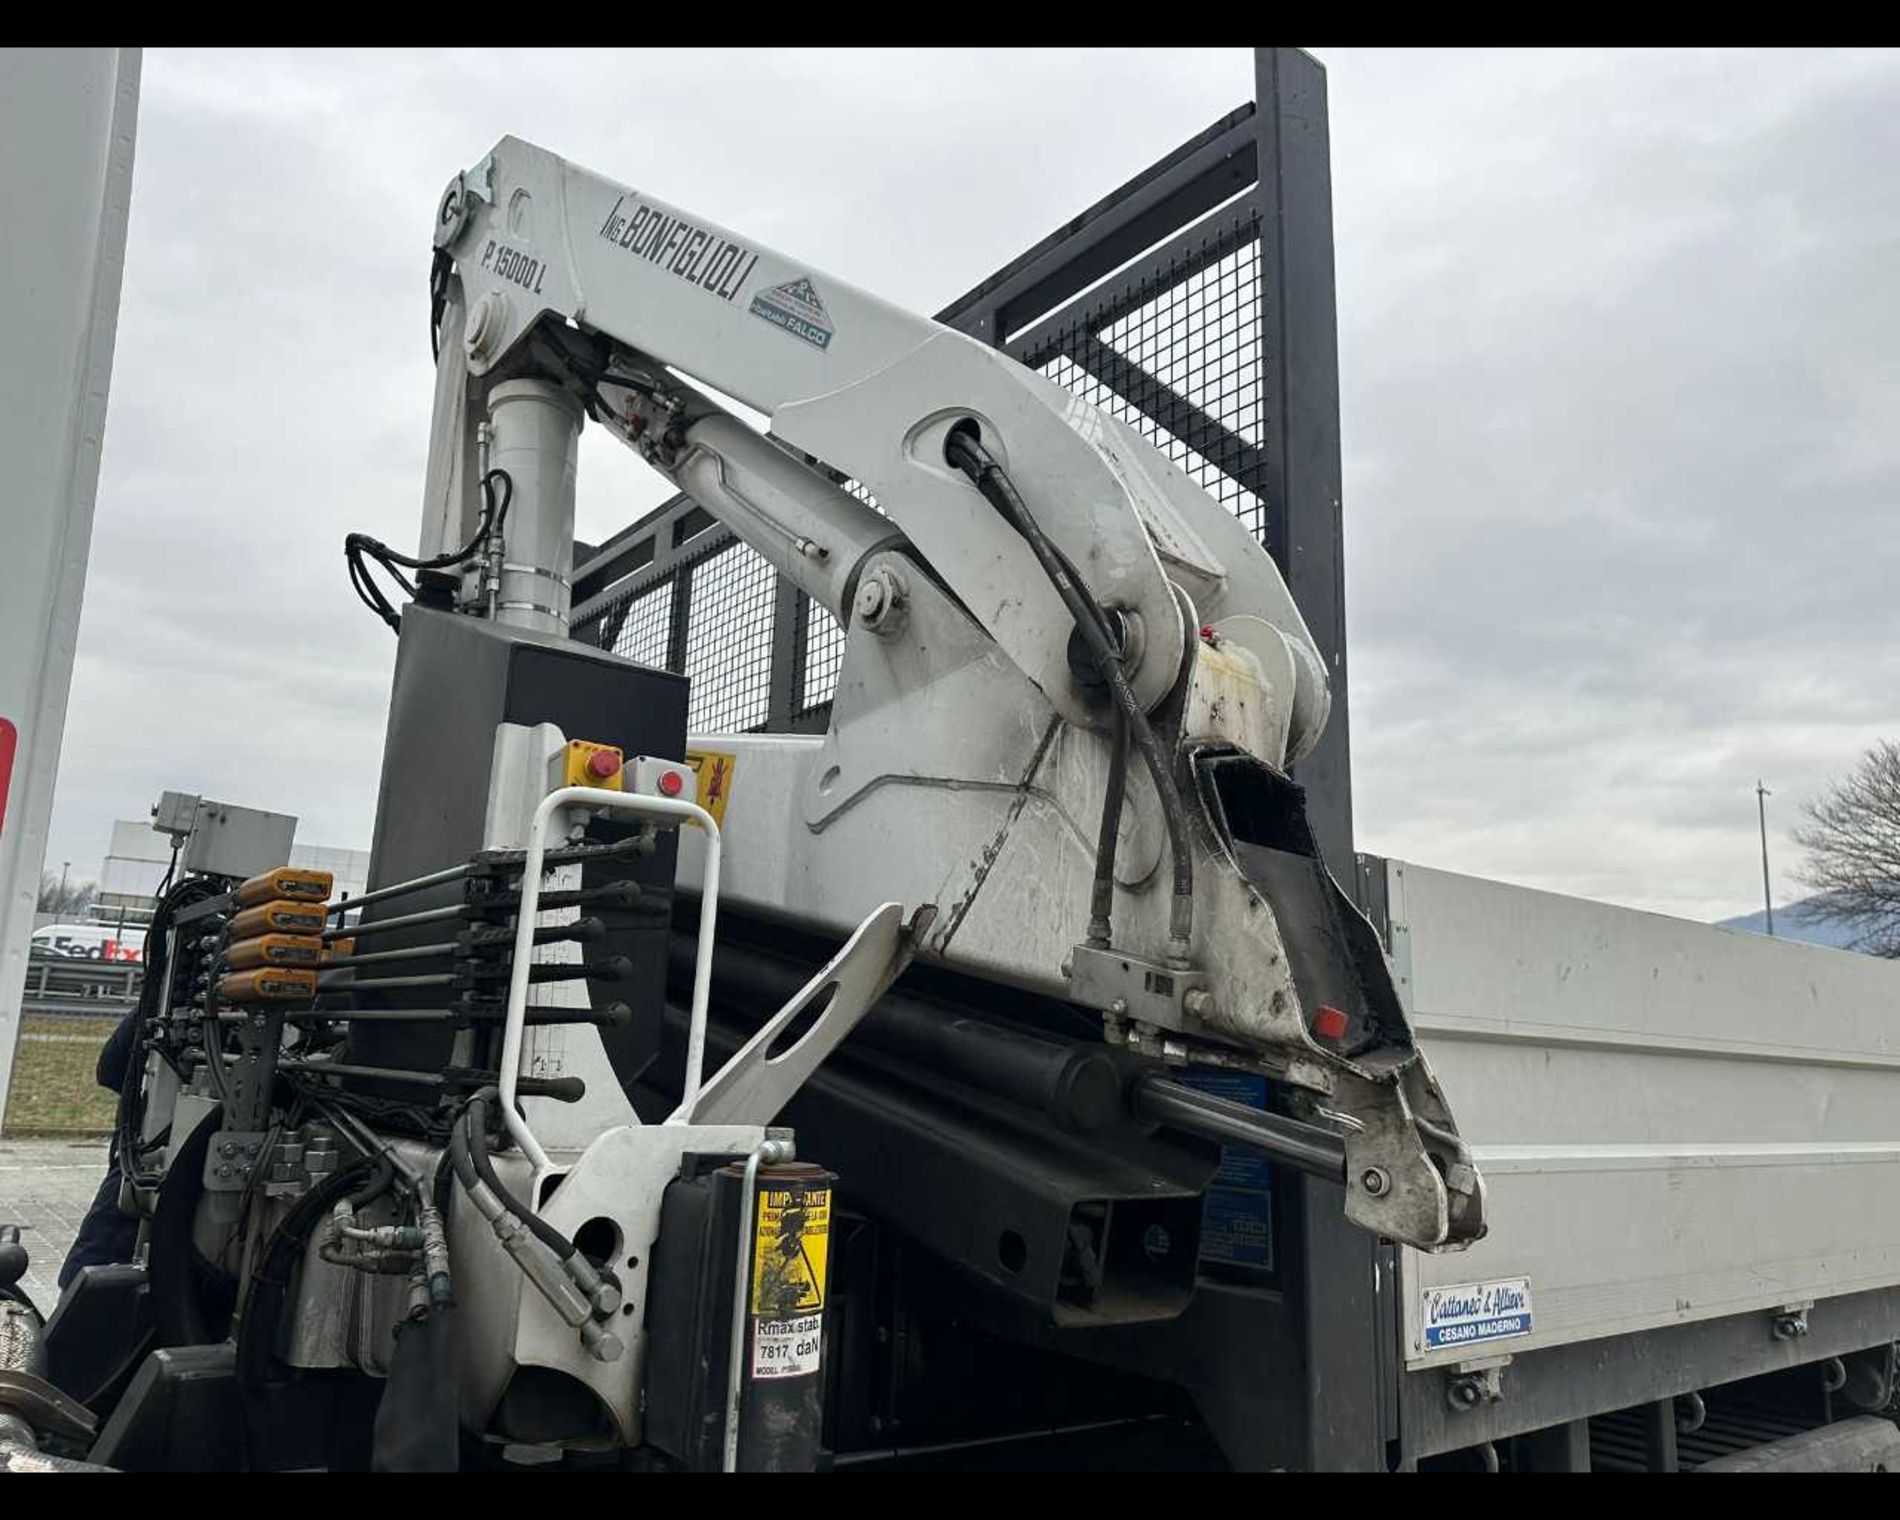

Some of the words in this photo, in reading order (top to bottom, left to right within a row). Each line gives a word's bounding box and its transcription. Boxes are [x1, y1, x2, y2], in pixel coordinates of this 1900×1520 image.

[619, 205, 759, 301] BONFIGLIOLI
[786, 317, 826, 345] FALCO
[55, 936, 143, 962] FedEx
[758, 1321, 795, 1335] Rmax
[1438, 1324, 1476, 1342] CESANO
[1478, 1317, 1521, 1336] MADERNO
[760, 1344, 789, 1359] 7817
[796, 1336, 819, 1356] daN
